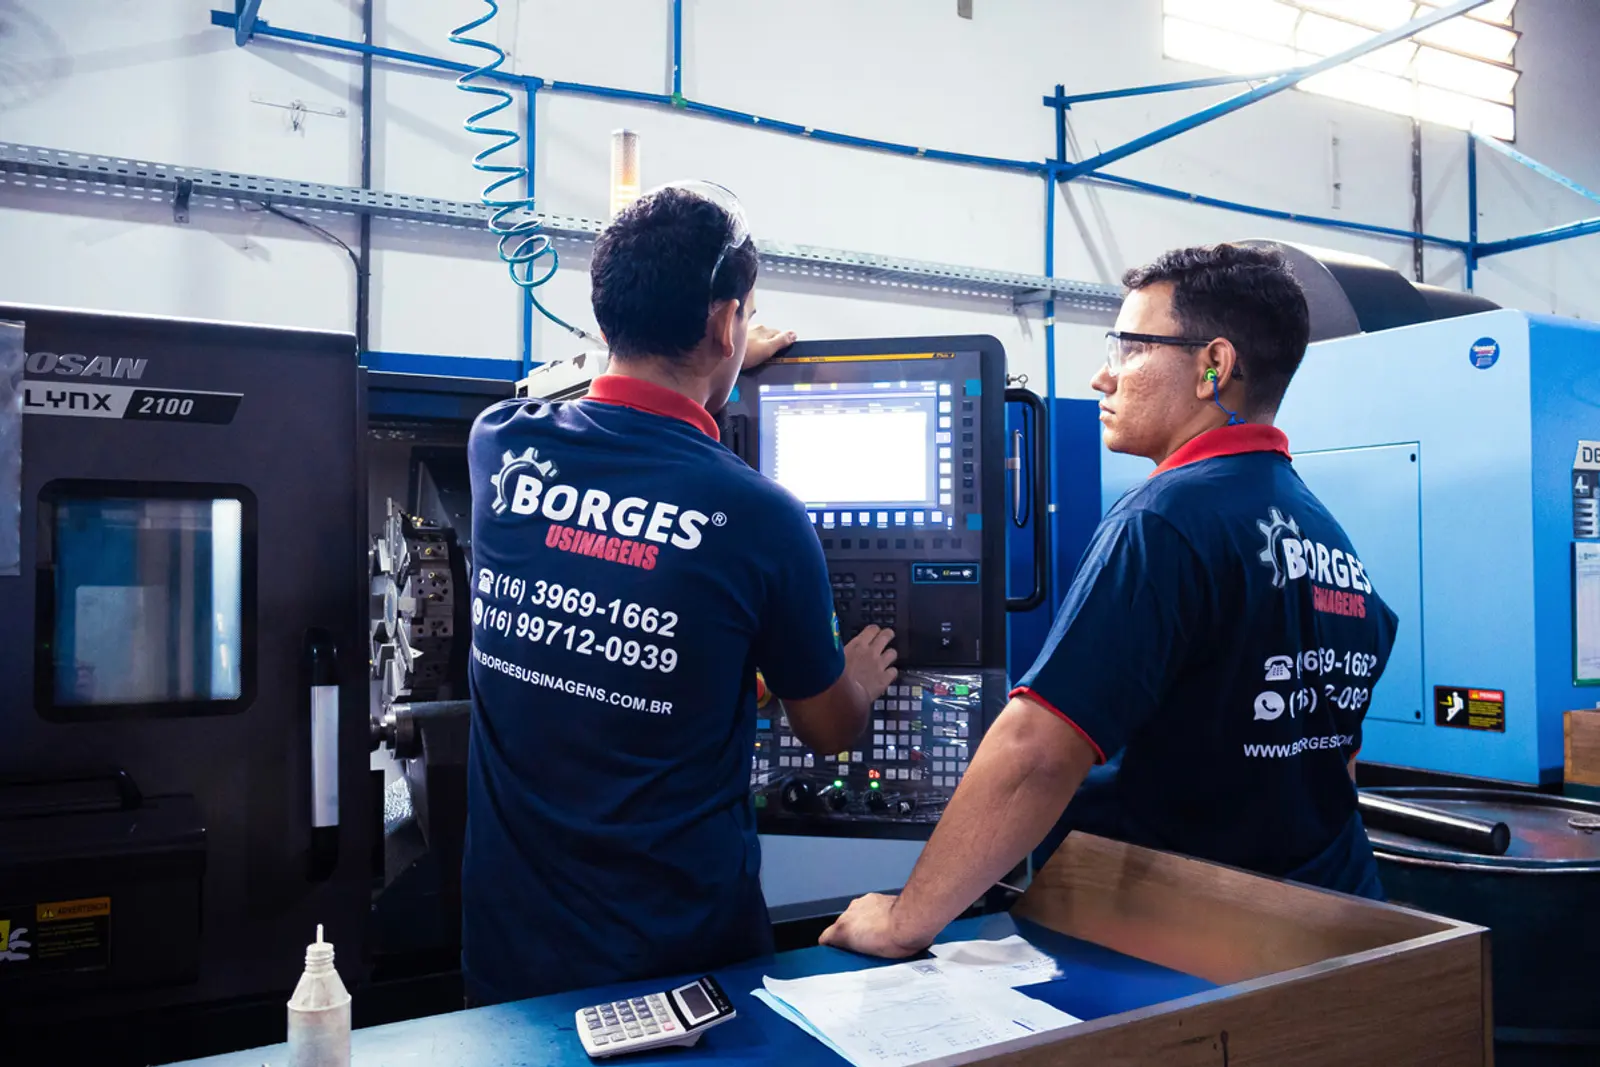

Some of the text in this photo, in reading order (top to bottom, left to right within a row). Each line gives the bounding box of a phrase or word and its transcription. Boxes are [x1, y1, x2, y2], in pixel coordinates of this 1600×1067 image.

[24, 351, 149, 380] OSAN
[138, 396, 195, 416] 2100
[545, 524, 659, 571] USINAGENS
[495, 573, 679, 638] (16) 3969-1662
[482, 605, 678, 674] (16) 99712-0939
